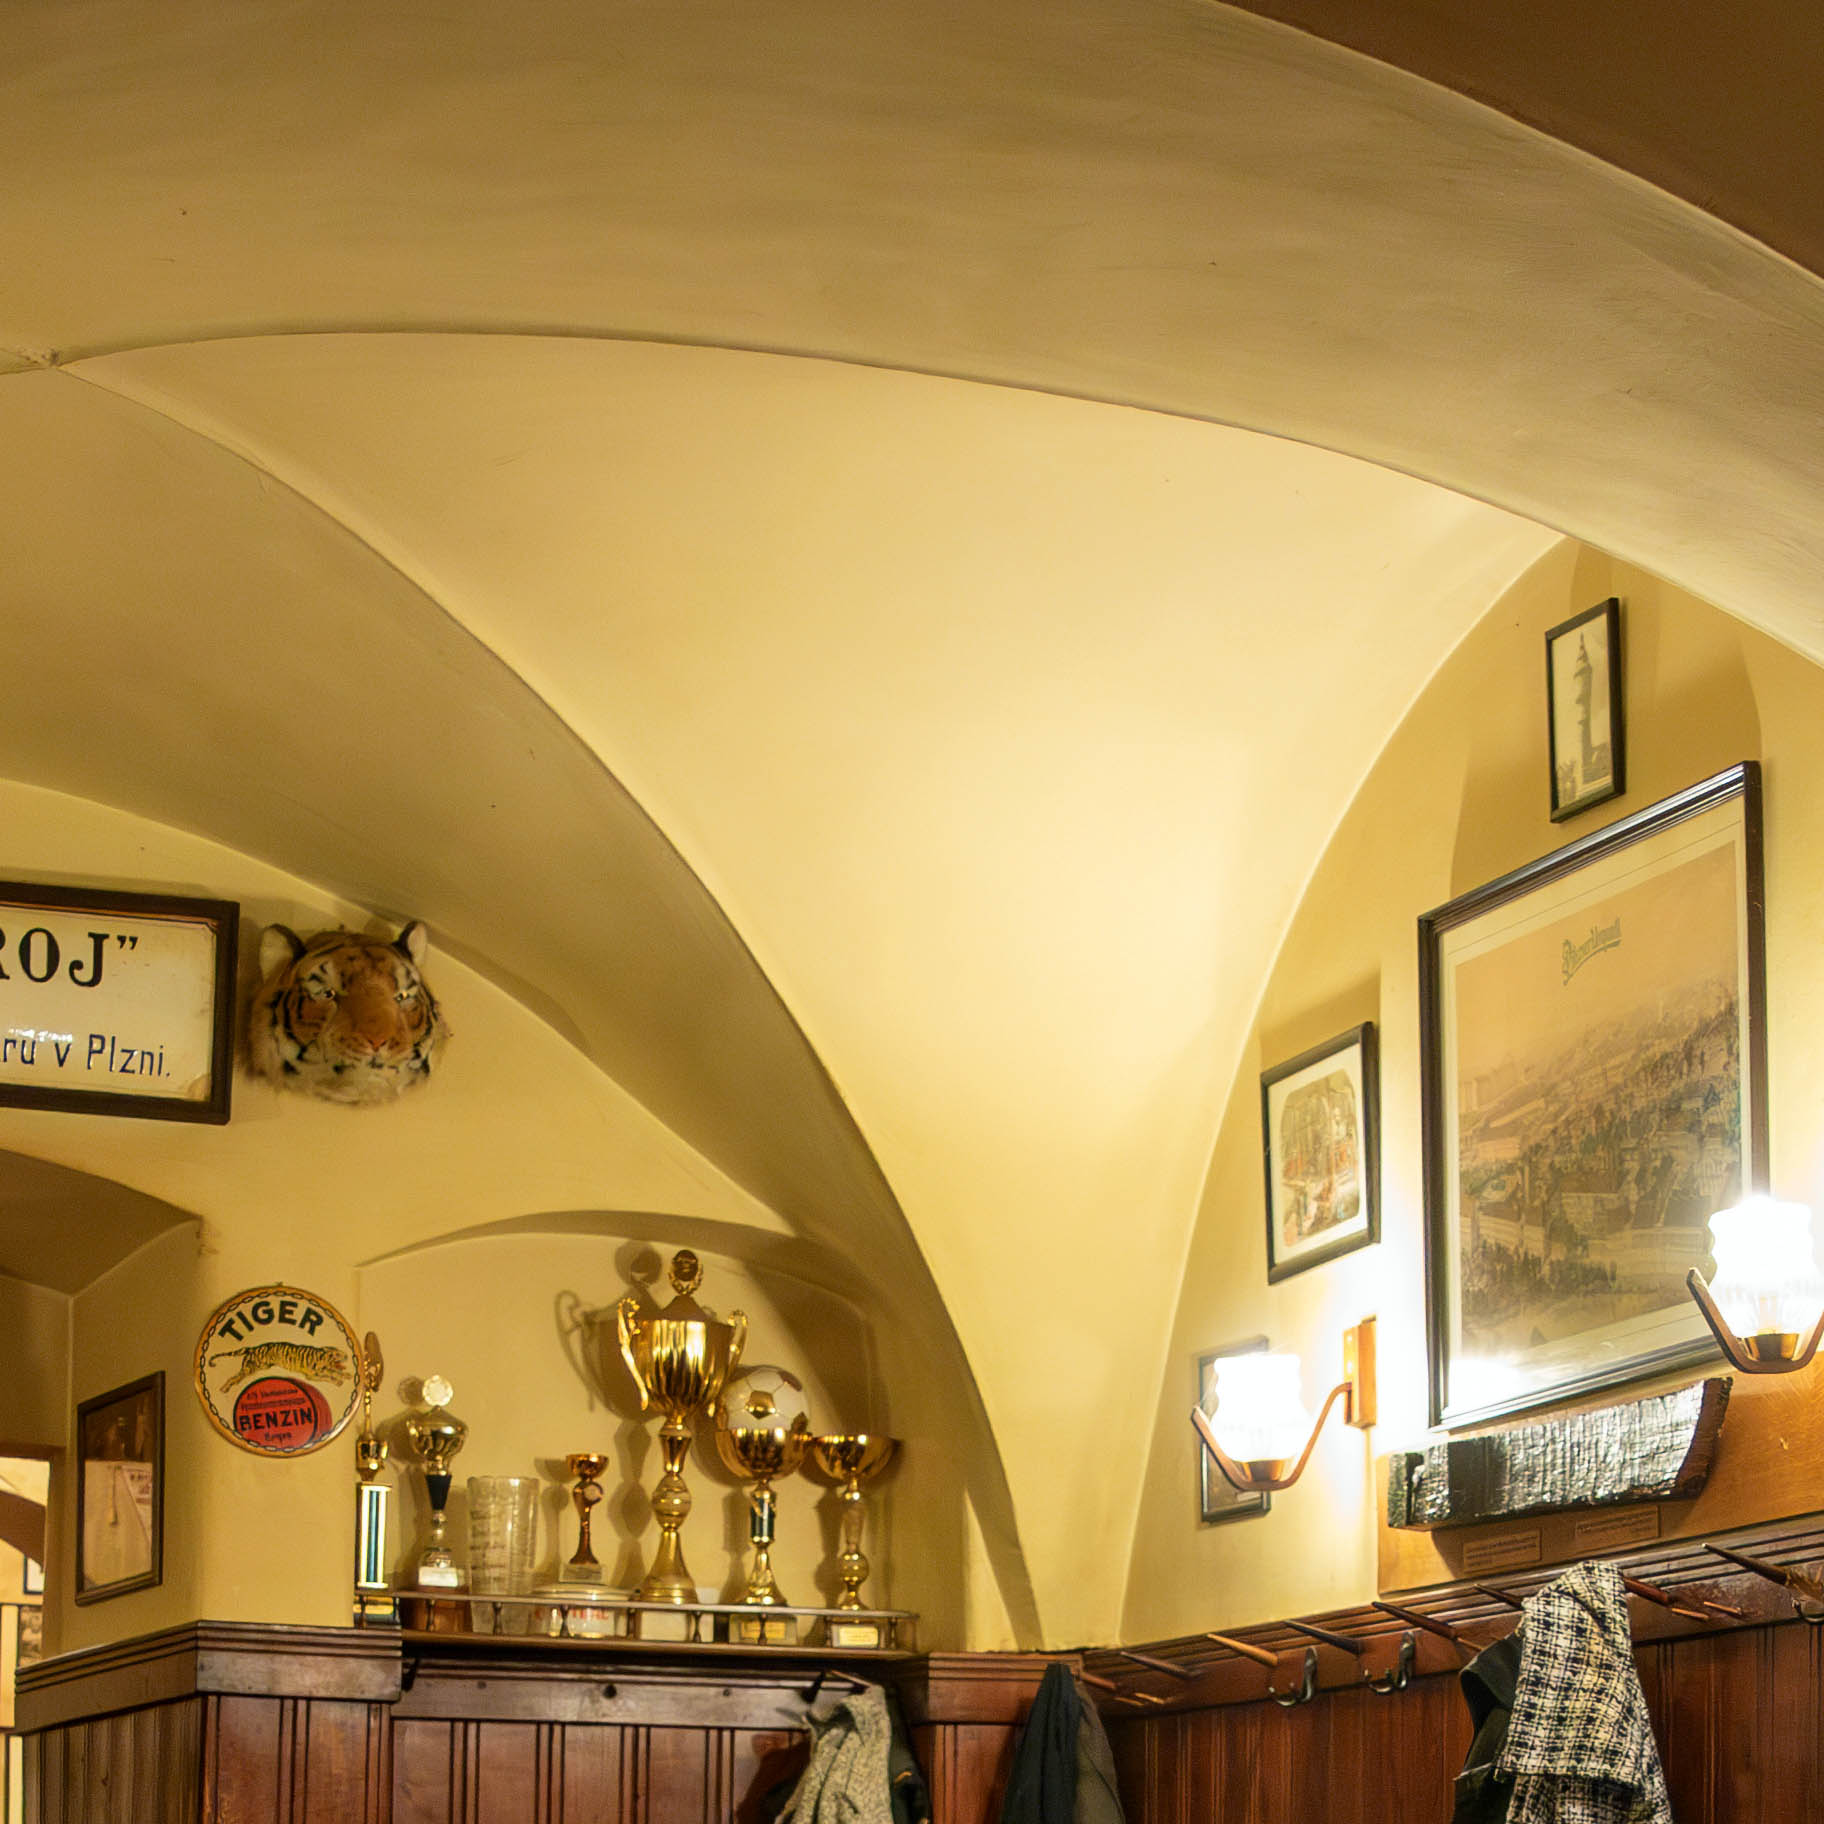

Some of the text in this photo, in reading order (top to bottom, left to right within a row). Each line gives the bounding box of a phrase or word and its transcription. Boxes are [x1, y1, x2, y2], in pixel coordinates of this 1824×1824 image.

[54, 1041, 73, 1068] v
[87, 1034, 172, 1078] Plzni.
[218, 1300, 324, 1342] TIGER
[239, 1407, 313, 1432] BENZIN
